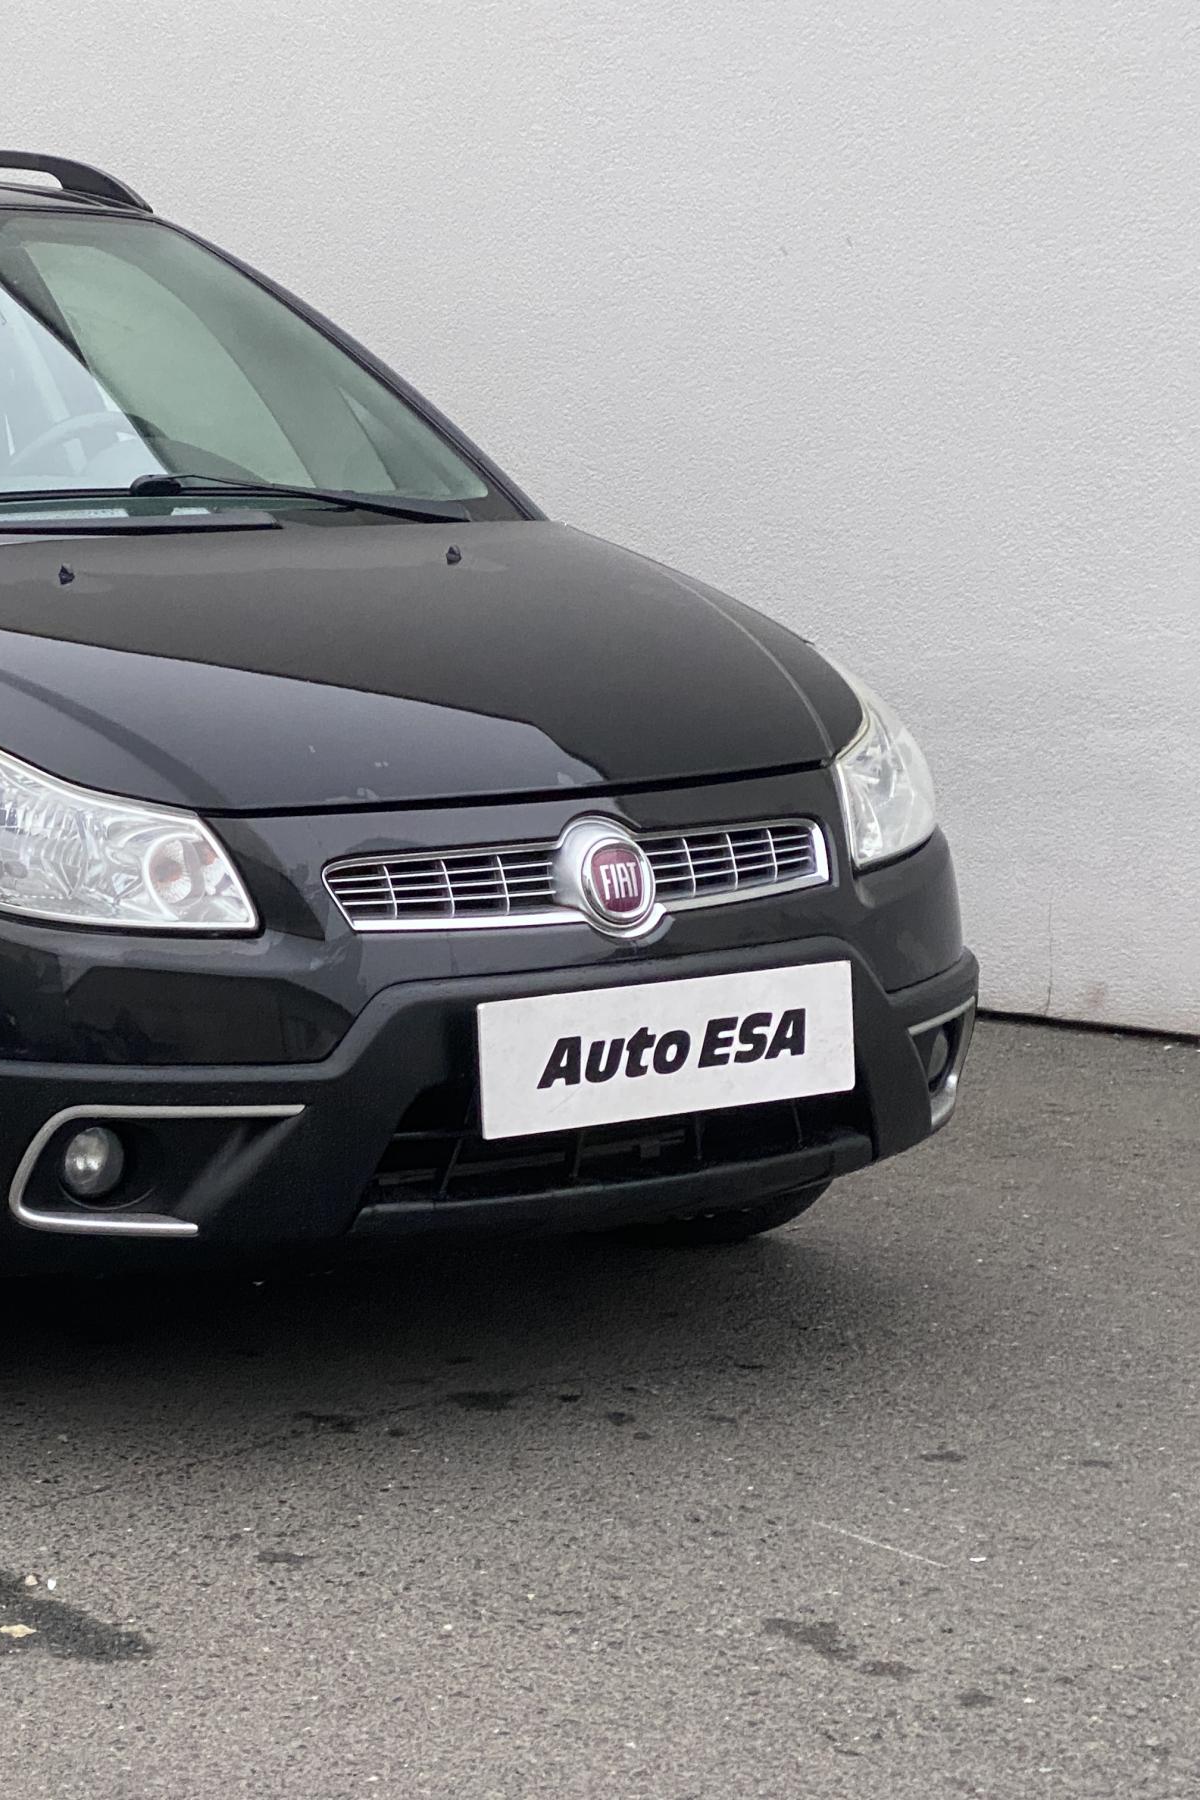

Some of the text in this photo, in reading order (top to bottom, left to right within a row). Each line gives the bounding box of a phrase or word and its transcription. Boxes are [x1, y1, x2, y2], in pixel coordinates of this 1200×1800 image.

[600, 862, 639, 900] FIAT
[536, 1008, 806, 1089] Auto ESA
